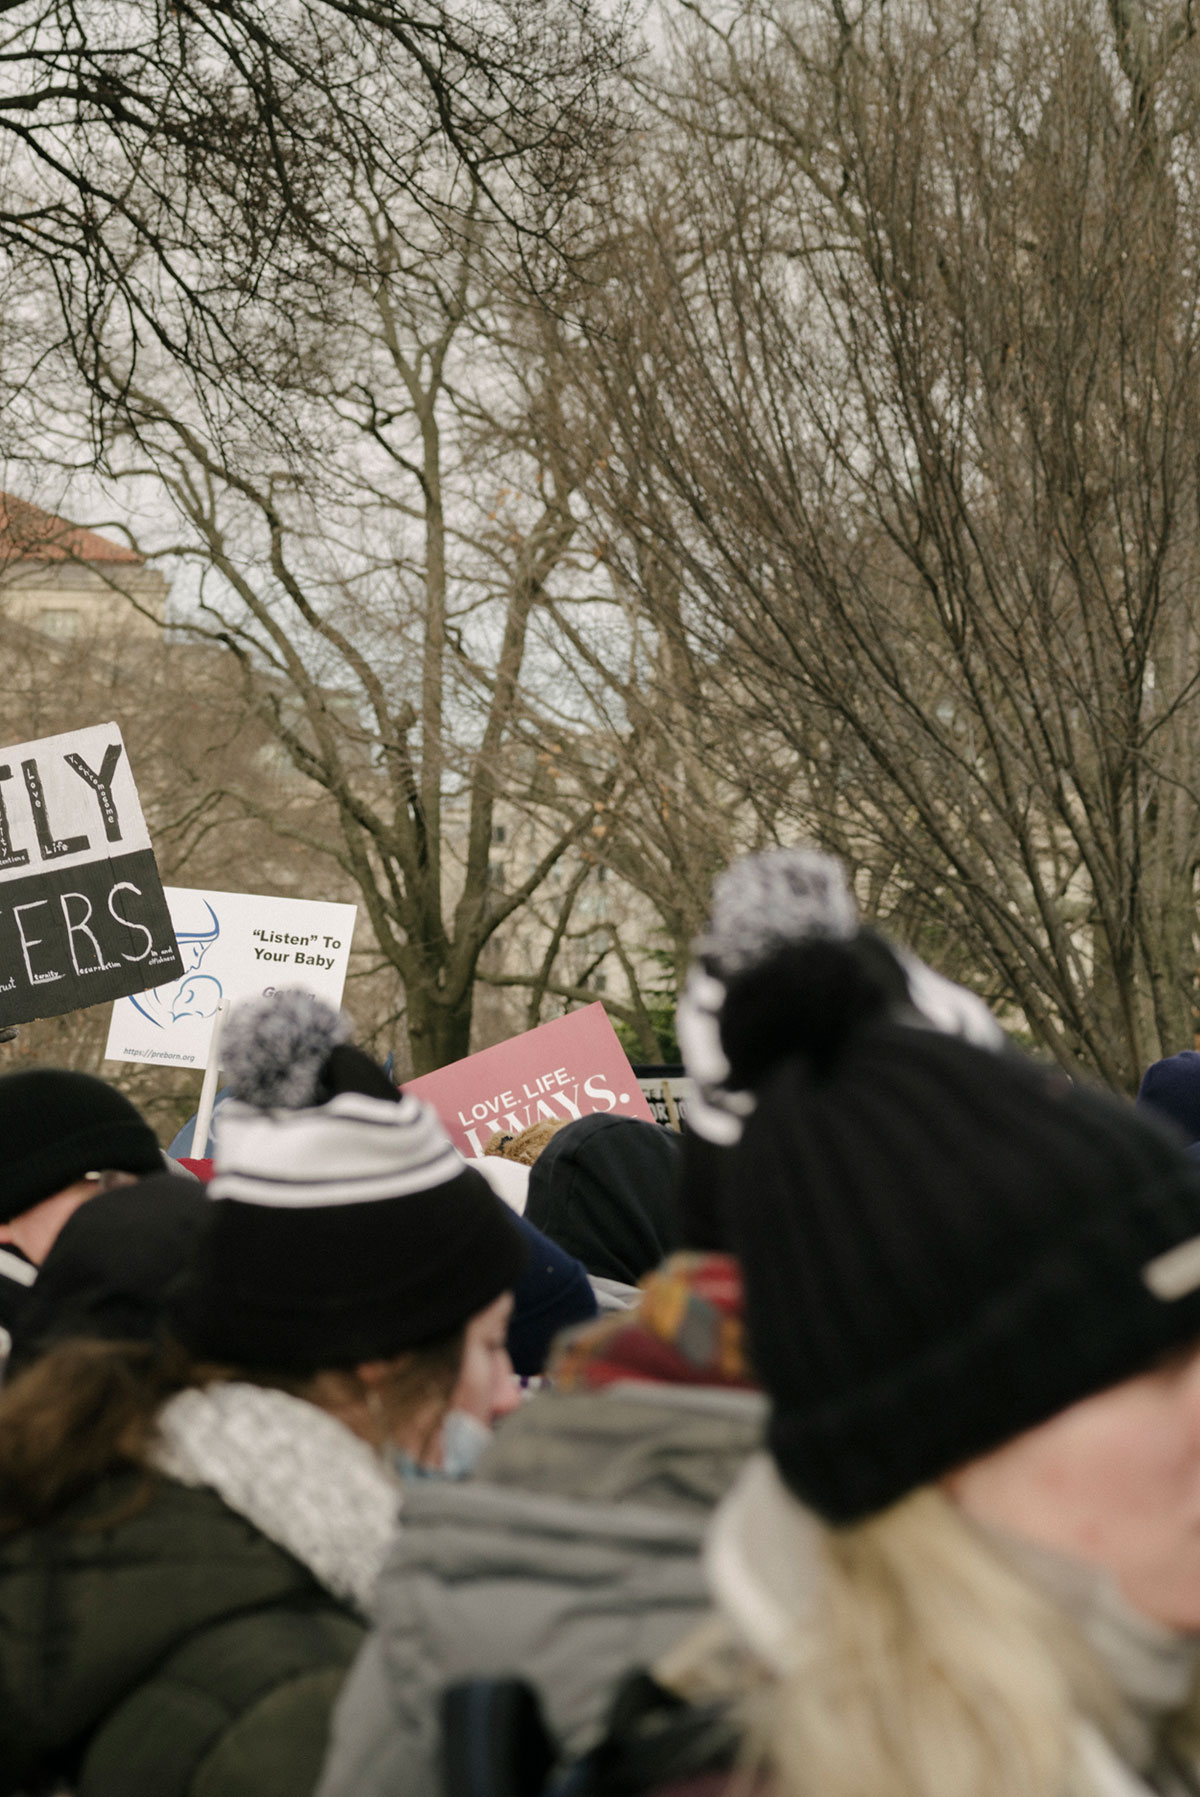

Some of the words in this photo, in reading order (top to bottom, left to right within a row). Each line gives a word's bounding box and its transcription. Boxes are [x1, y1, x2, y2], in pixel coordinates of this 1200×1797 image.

[26, 768, 42, 808] Love
[43, 841, 69, 855] Life
[323, 936, 342, 949] To
[254, 948, 290, 963] Your
[294, 952, 335, 970] Baby
[123, 1047, 196, 1063] https://preborn.org
[458, 1090, 522, 1127] LOVE.
[523, 1067, 576, 1099] LIFE.
[463, 1074, 631, 1159] LWAYS.
